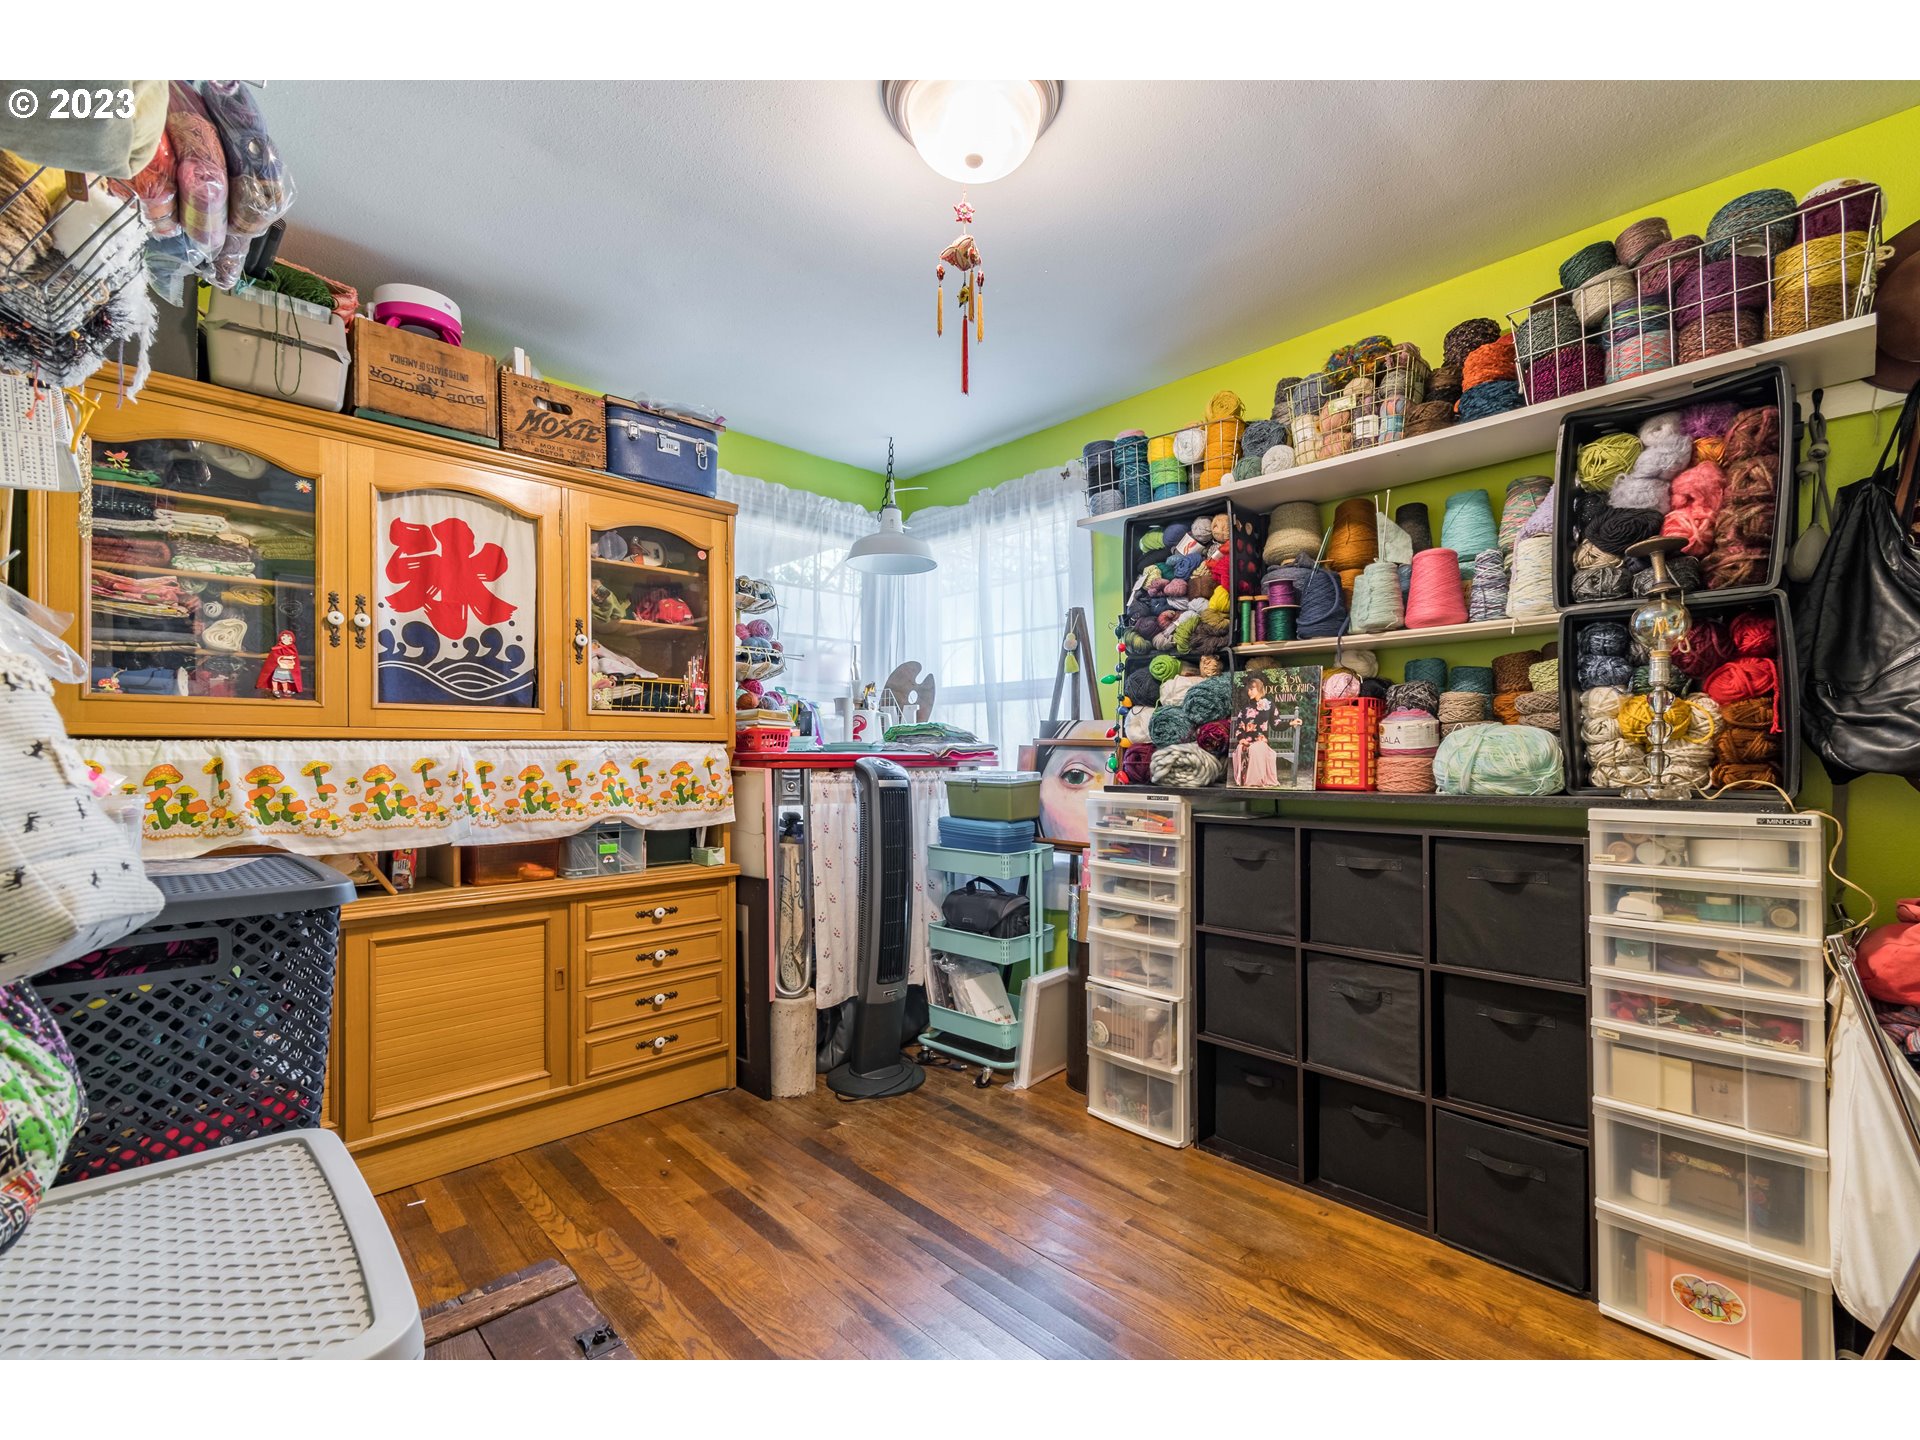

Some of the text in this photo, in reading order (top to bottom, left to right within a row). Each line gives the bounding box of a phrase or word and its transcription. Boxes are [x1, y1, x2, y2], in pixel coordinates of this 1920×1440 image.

[389, 353, 469, 382] UNITED STATES OF AMERICA
[412, 372, 446, 388] INC.
[369, 365, 486, 405] BLUE ANCHOR
[521, 382, 550, 393] DOZEN
[515, 409, 602, 443] MOXIE
[520, 439, 601, 460] THE MOXIE COMPANY
[534, 447, 565, 458] BOSTON
[385, 517, 518, 640] 氷
